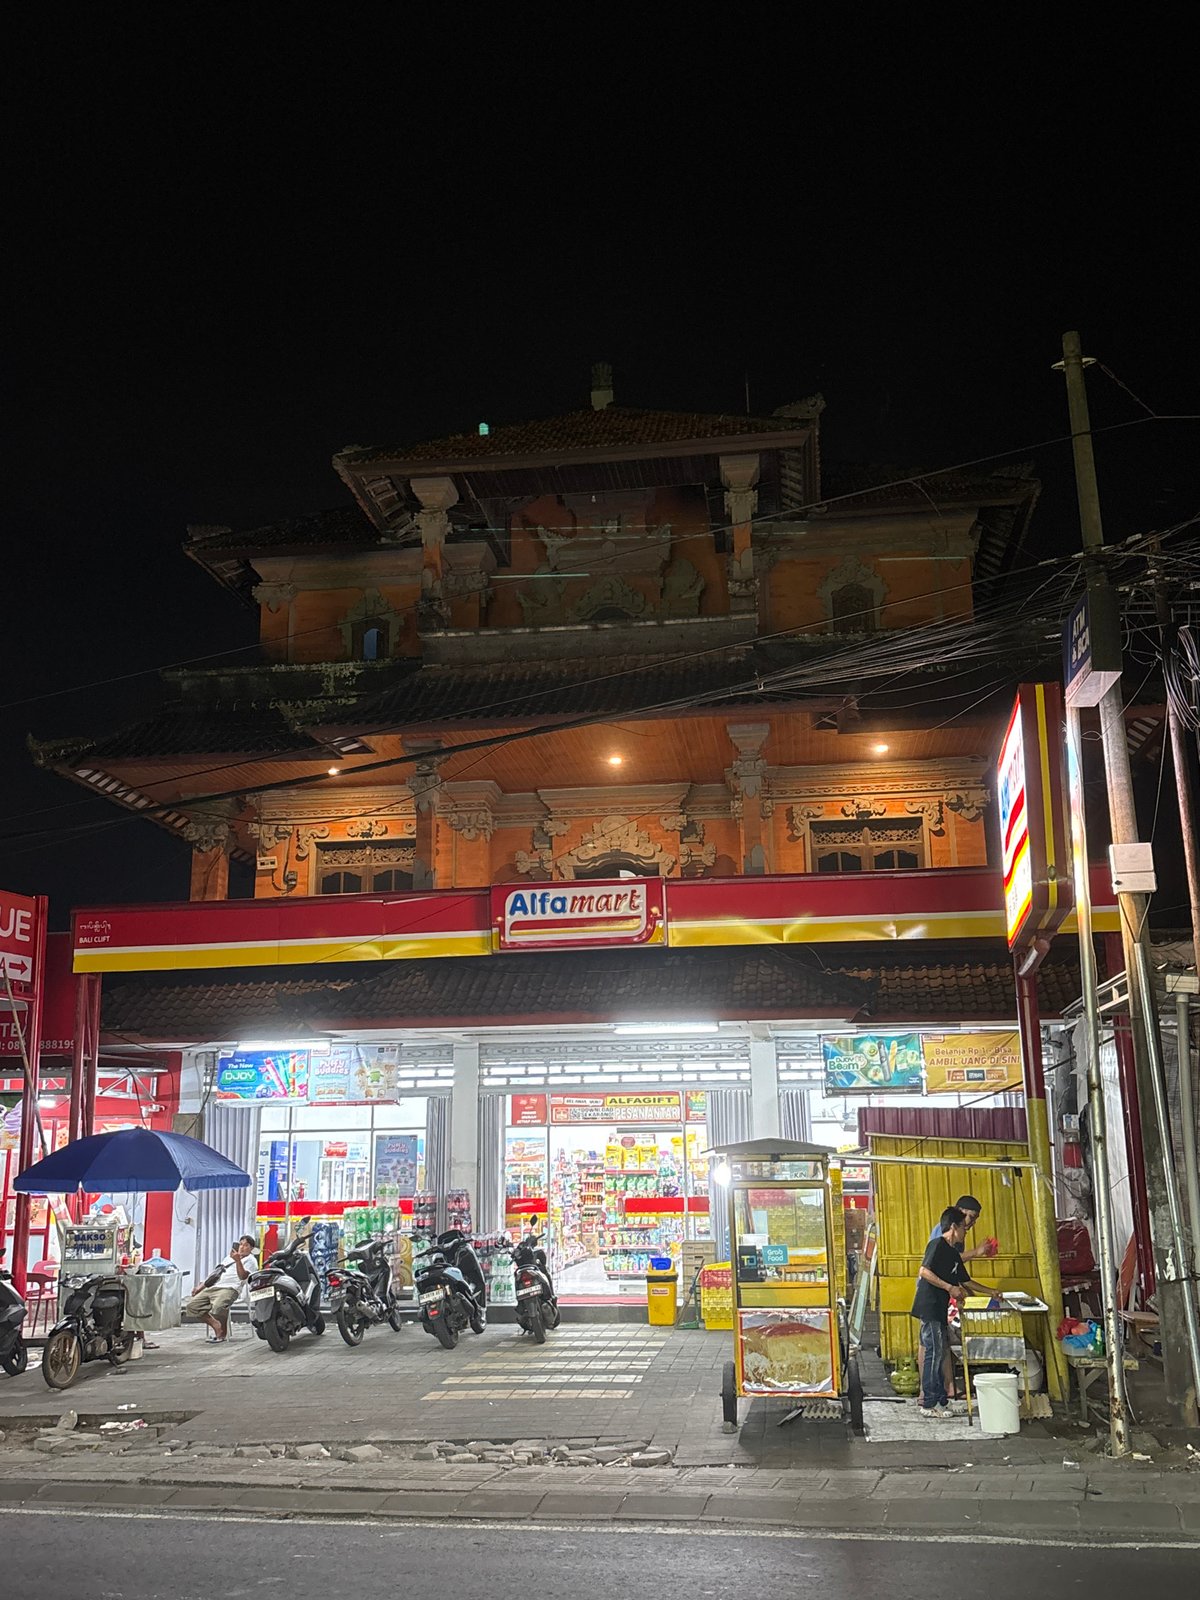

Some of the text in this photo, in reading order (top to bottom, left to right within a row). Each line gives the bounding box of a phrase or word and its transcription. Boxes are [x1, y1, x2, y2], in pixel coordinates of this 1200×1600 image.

[1072, 605, 1086, 642] ATM
[509, 889, 642, 916] Alfamart
[94, 935, 111, 943] CLIFT
[935, 1047, 966, 1056] Belanja
[968, 1047, 978, 1055] Rp
[994, 1046, 1012, 1054] Bisa
[829, 1060, 859, 1070] Beam
[929, 1055, 1020, 1066] AMBIL UANG DI SINI
[225, 1071, 255, 1080] DJOY
[615, 1106, 645, 1119] PESAN
[647, 1106, 679, 1119] ANTAR
[74, 1233, 106, 1241] BAKSO
